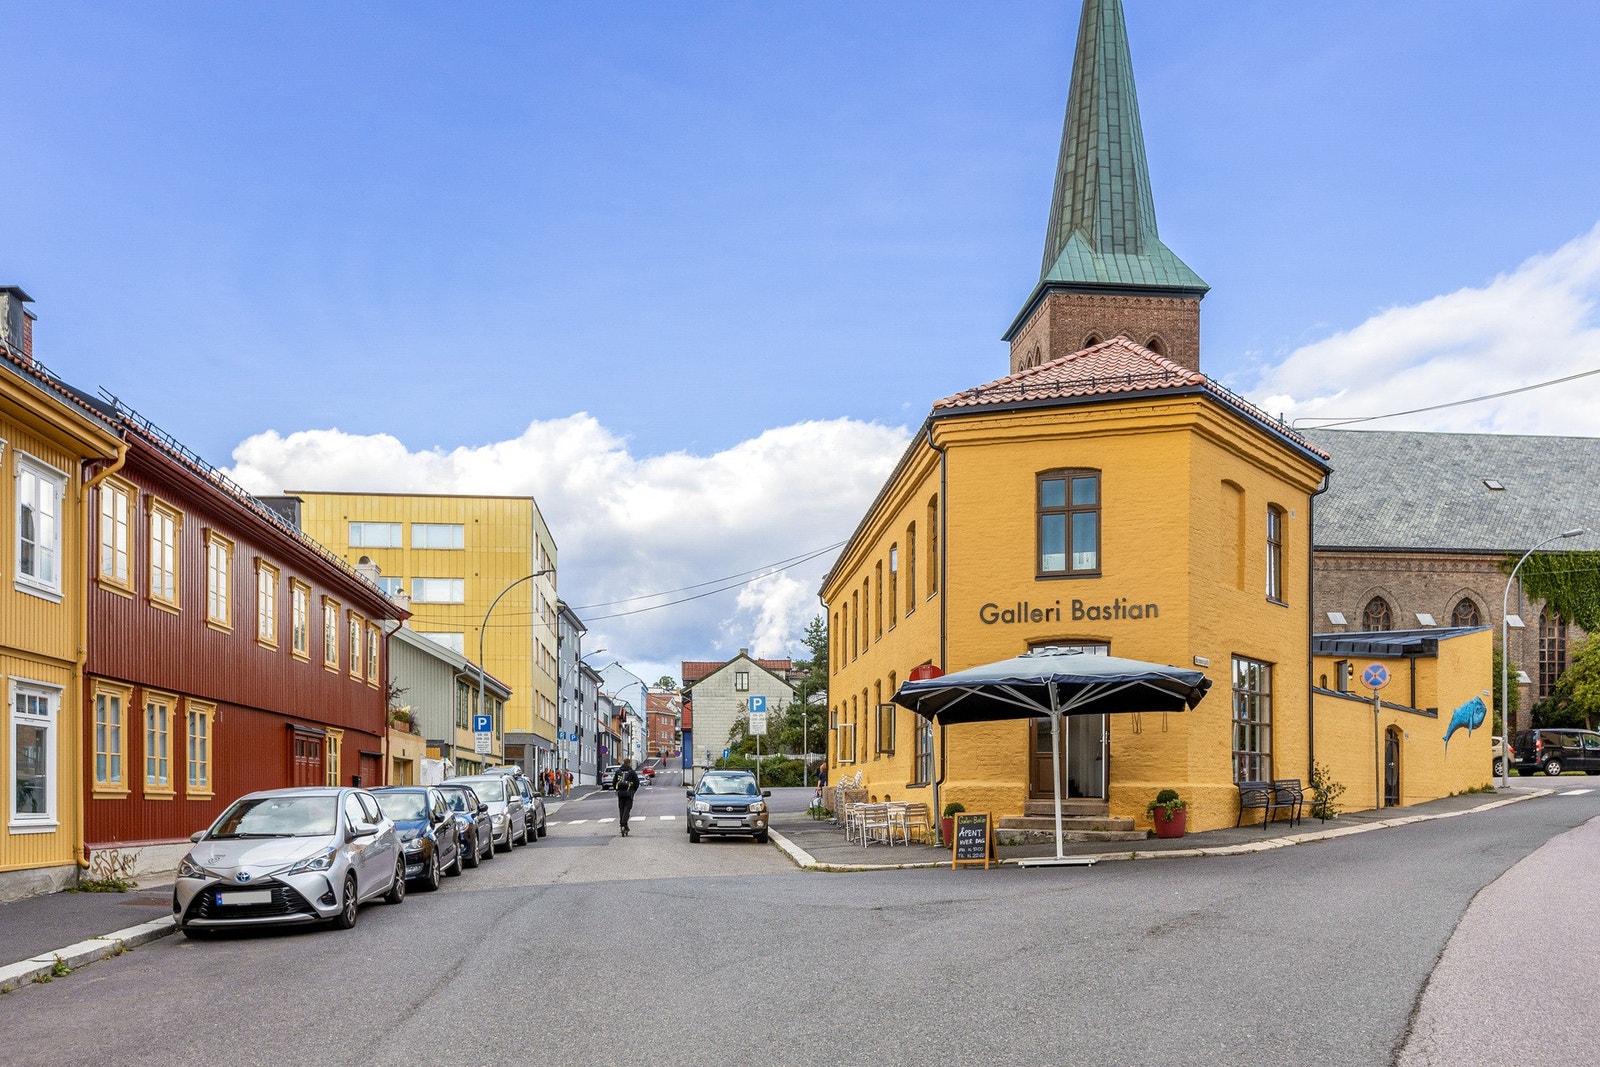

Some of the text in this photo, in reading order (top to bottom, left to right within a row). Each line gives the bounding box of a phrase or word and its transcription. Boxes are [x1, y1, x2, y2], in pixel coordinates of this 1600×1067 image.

[979, 597, 1159, 625] Galleri Bastian
[752, 697, 763, 711] P
[477, 717, 487, 730] P
[958, 827, 982, 837] ÅPENT
